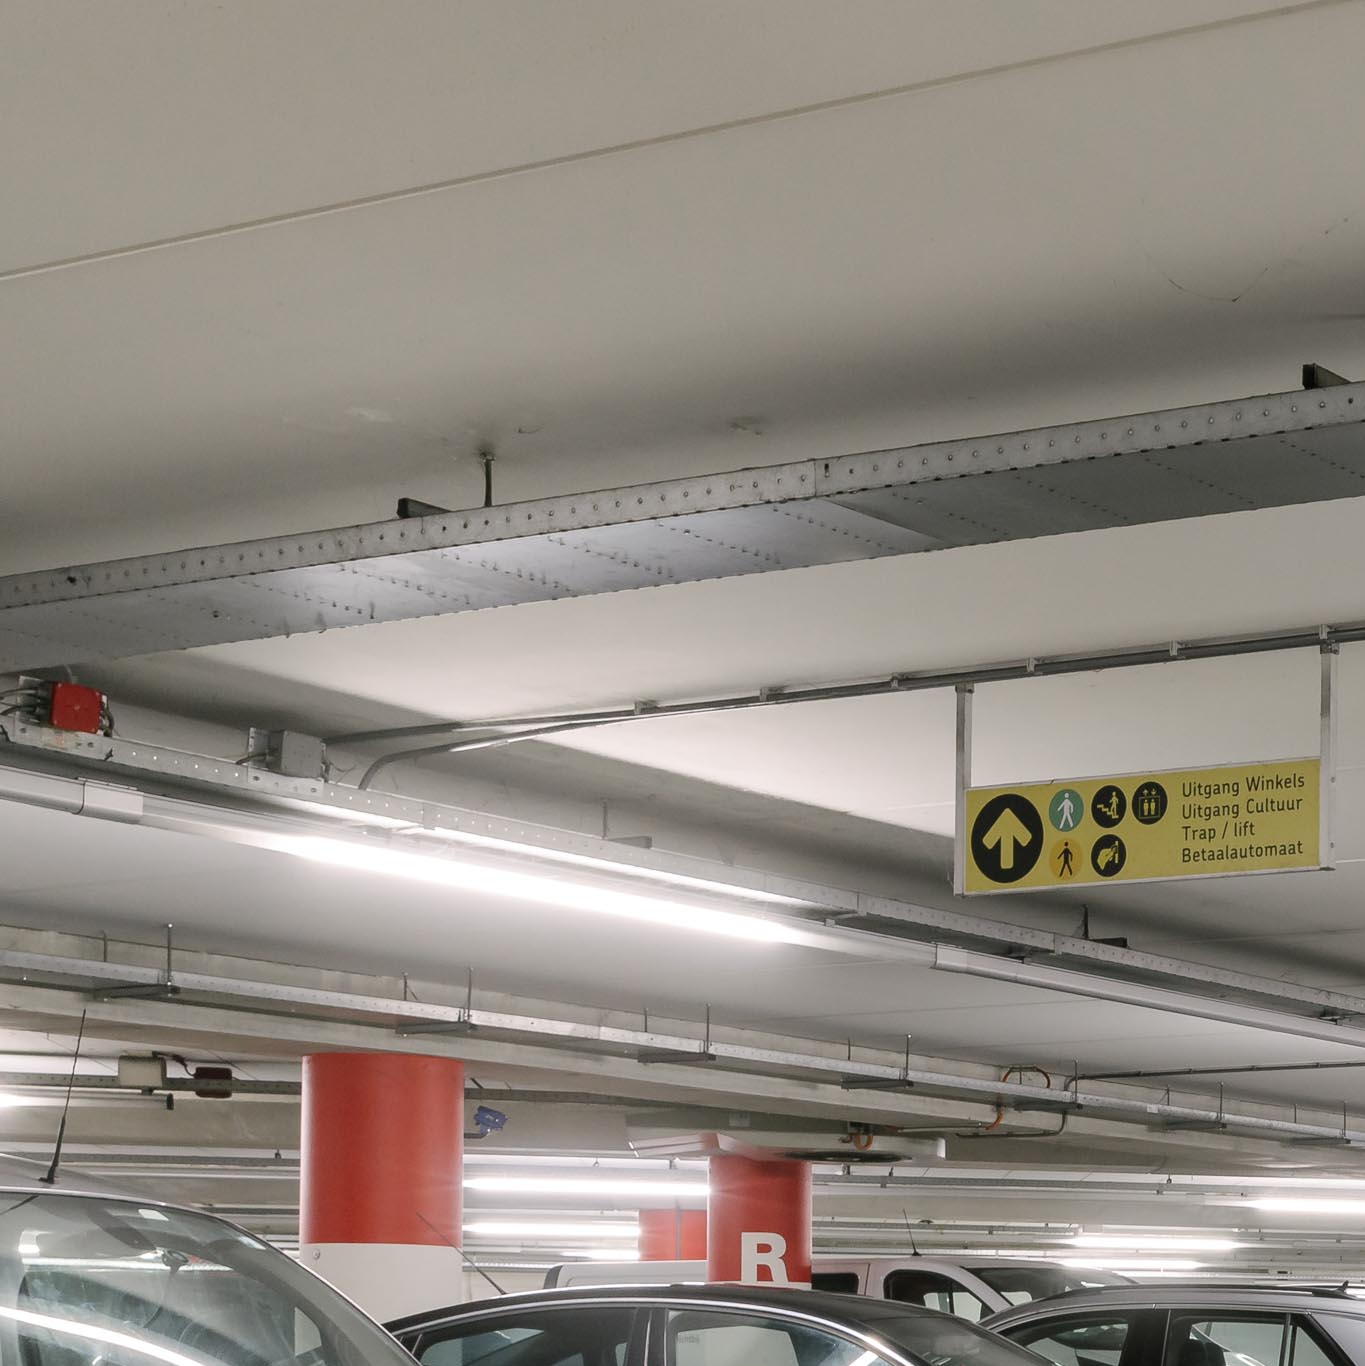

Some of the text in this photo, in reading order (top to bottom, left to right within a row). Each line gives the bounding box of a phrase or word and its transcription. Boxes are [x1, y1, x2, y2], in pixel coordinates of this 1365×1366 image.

[1182, 774, 1305, 798] Uitgang Winkels
[1182, 798, 1303, 821] Uitgang Cultuur
[1182, 820, 1255, 842] Trap / lift
[1182, 841, 1303, 863] Betaalautomaat
[741, 1231, 788, 1284] R
